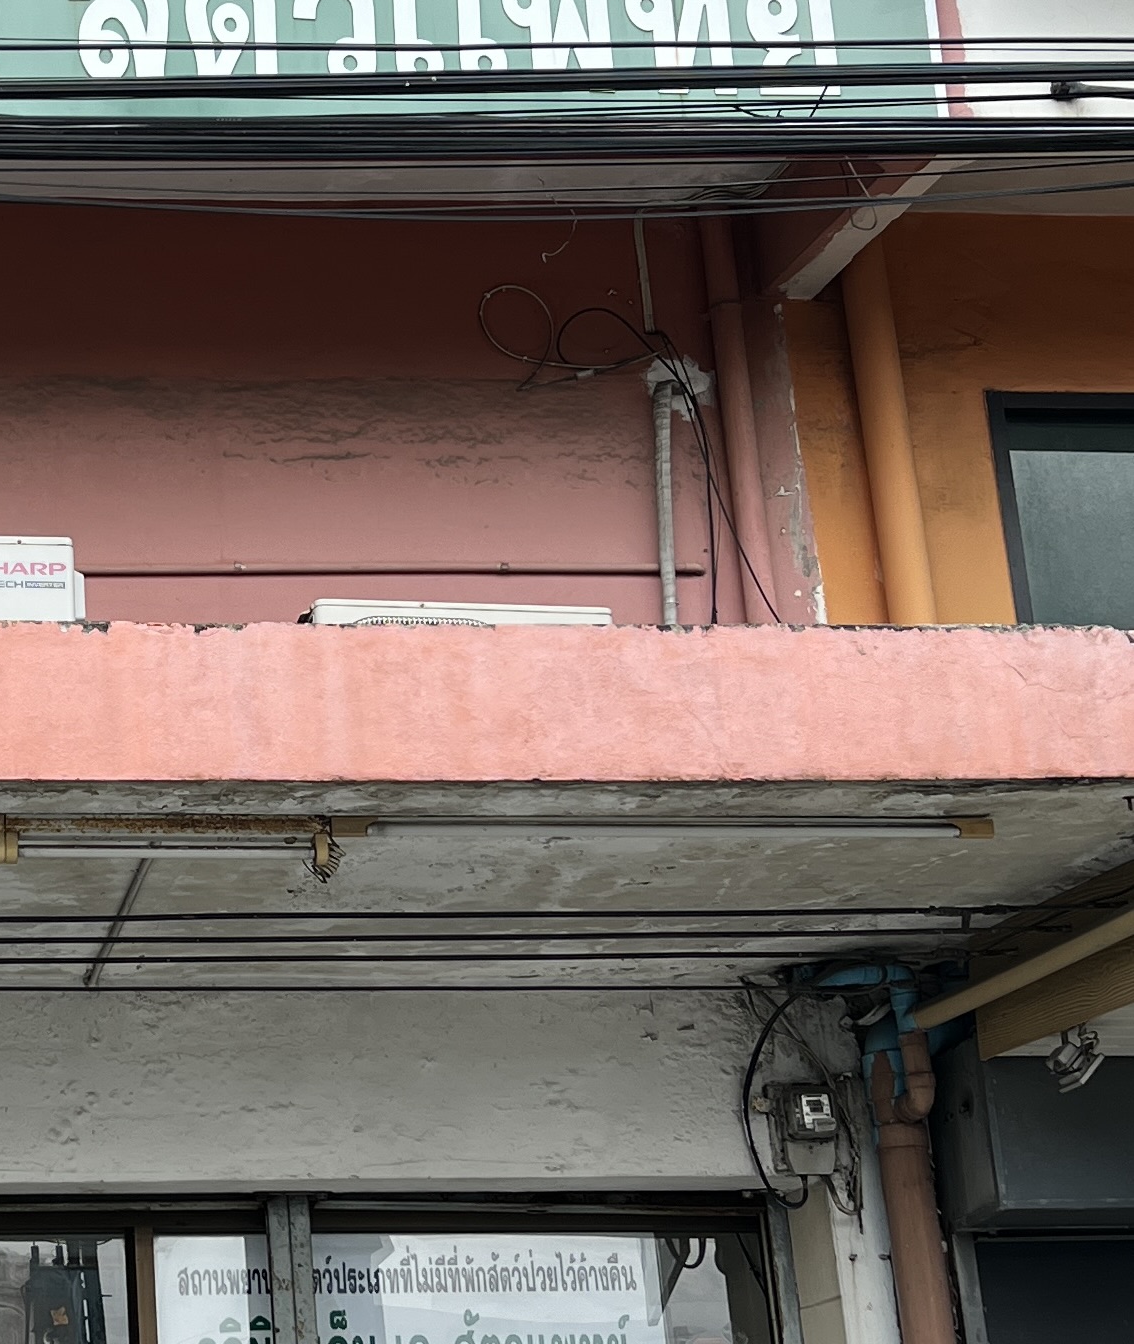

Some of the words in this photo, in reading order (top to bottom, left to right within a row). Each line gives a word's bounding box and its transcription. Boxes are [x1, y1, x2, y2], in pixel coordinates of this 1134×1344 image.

[177, 1245, 637, 1296] สถานพยาบตว์ประเภทที่ไม่มีที่พักสัตว์ป่วยไว้ค้างคืน
